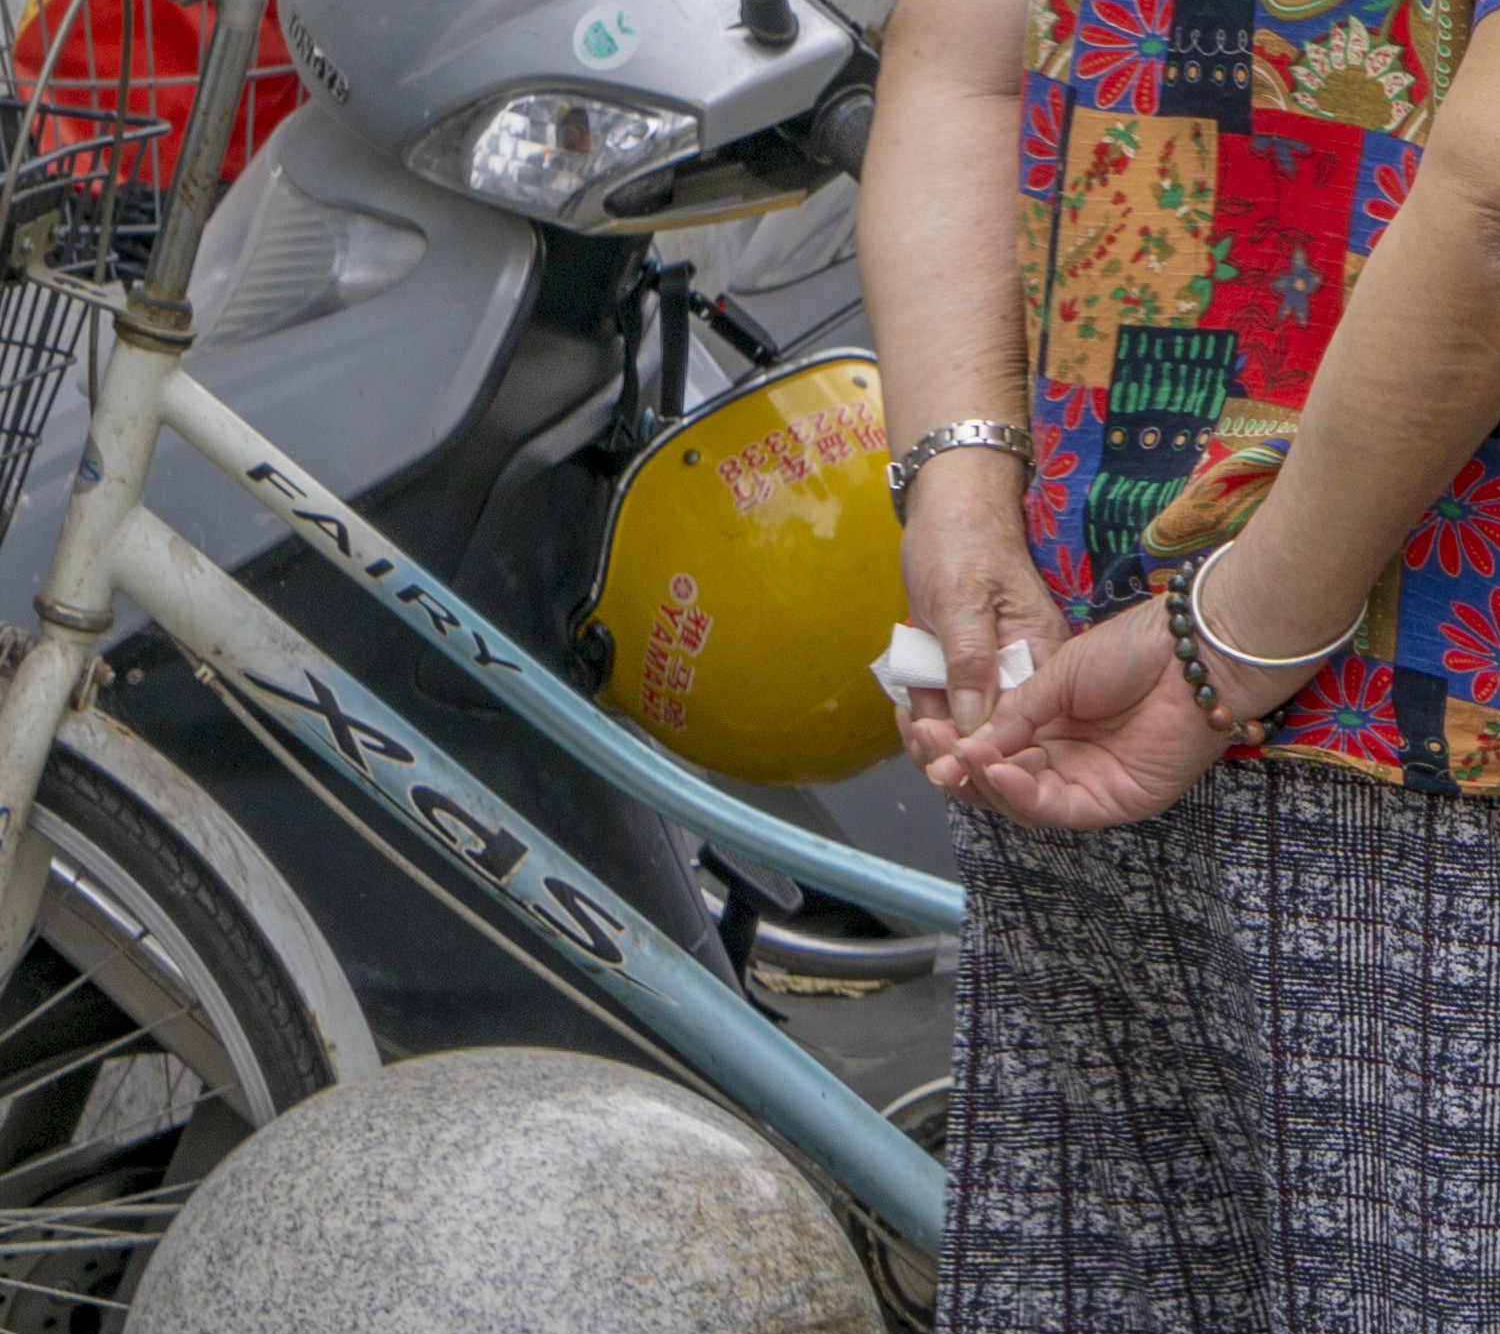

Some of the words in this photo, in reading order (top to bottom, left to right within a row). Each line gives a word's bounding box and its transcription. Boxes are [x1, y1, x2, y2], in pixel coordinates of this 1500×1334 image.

[716, 402, 874, 486] 2223338
[246, 461, 523, 673] FAIRY
[641, 603, 684, 724] YAMAHA
[664, 605, 713, 731] 雅马哈
